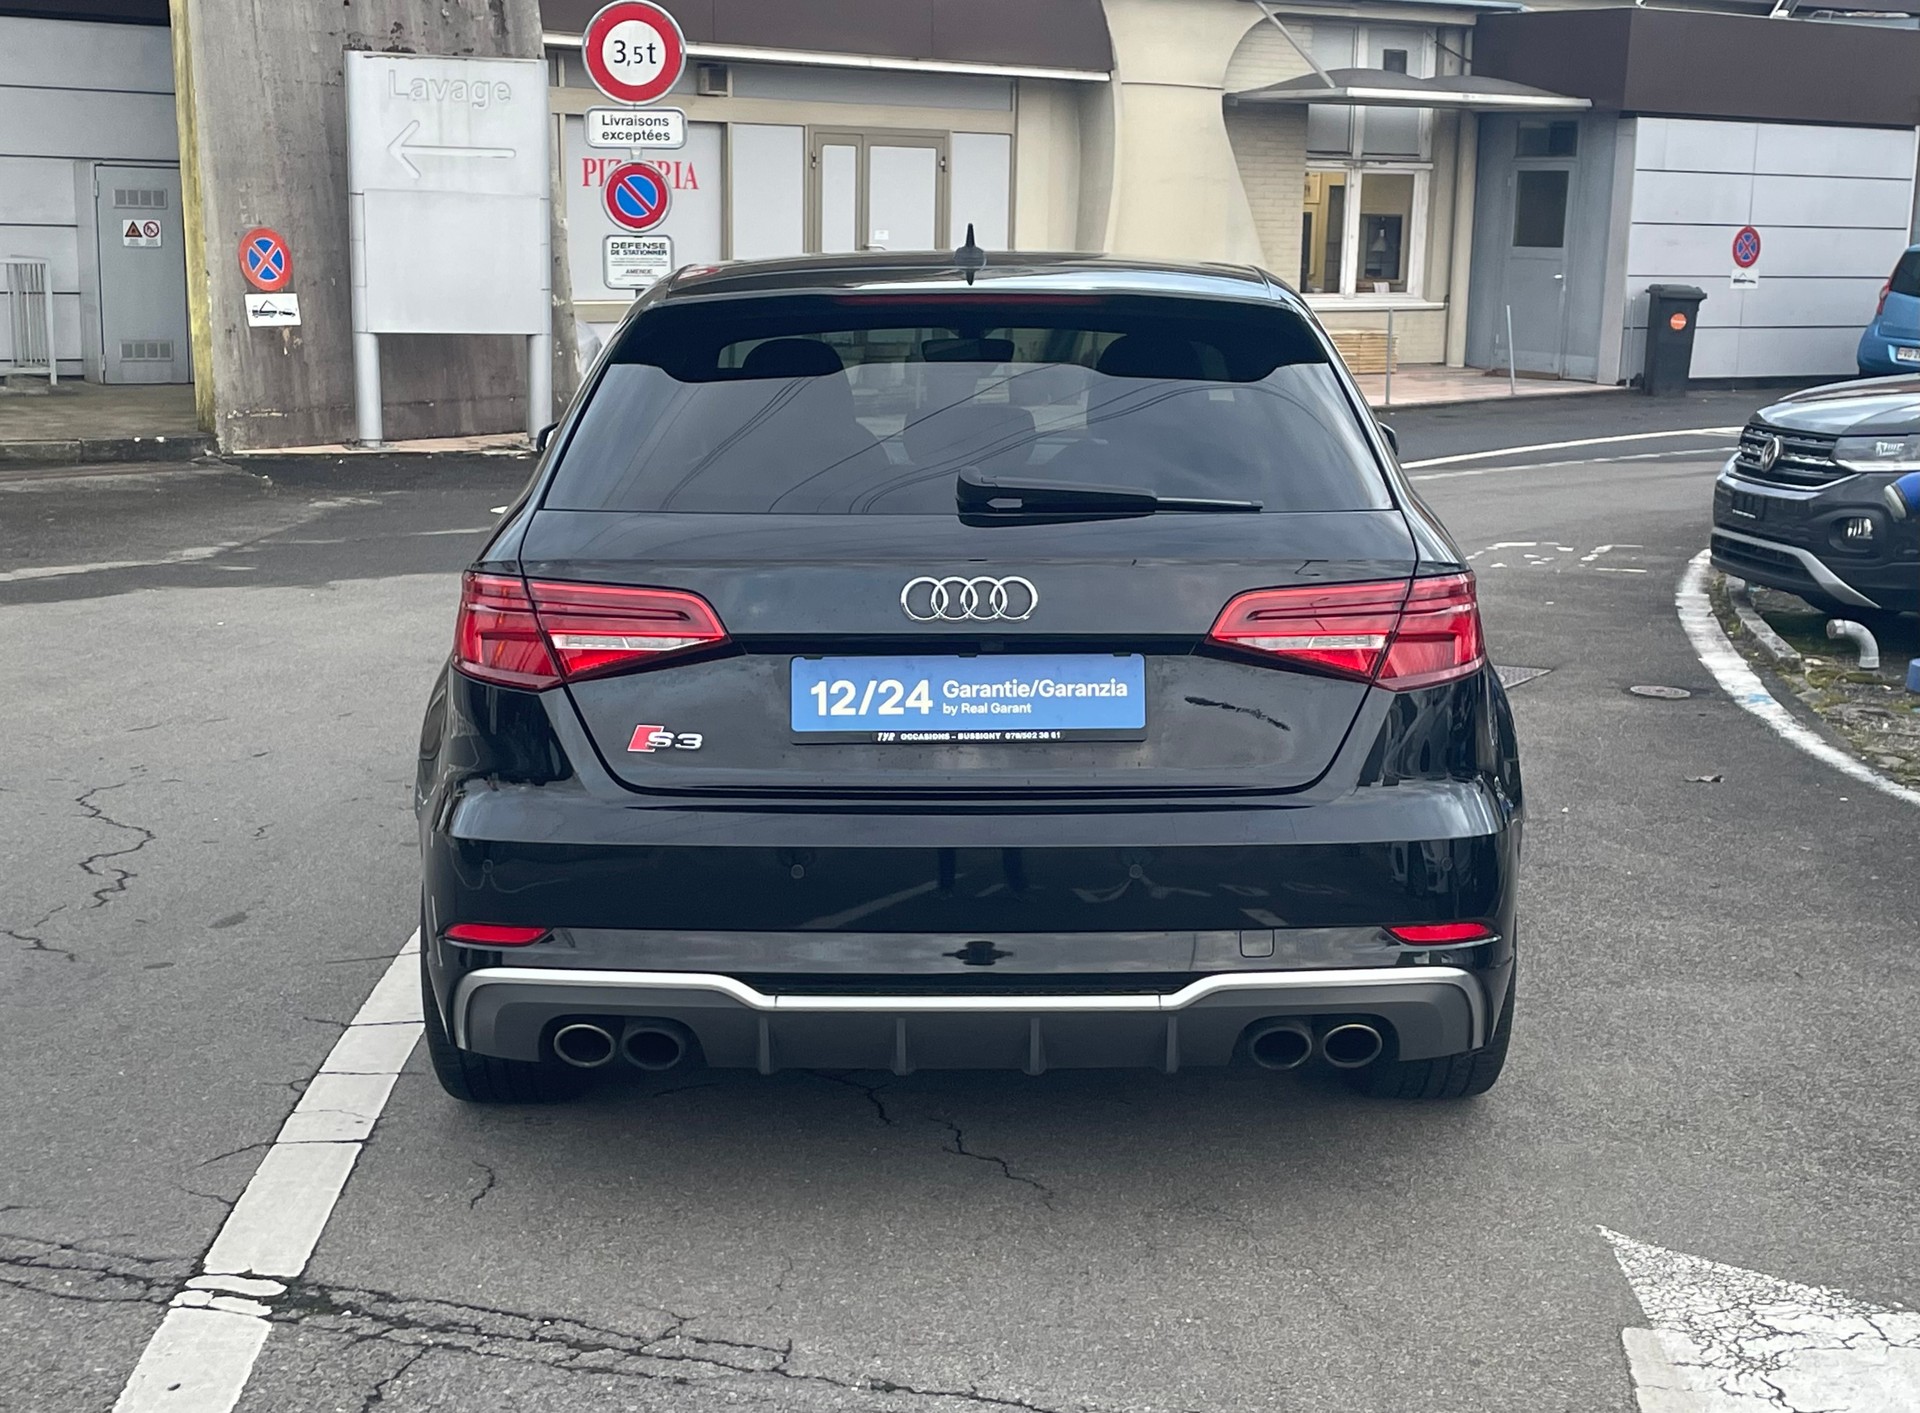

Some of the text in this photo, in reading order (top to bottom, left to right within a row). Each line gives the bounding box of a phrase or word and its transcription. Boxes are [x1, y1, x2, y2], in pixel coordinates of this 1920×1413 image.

[388, 69, 512, 110] Lavage
[601, 114, 670, 127] Livraisons
[601, 130, 671, 143] exceptées
[582, 157, 699, 190] PIRIA
[810, 679, 934, 717] 12/24
[942, 678, 1128, 699] Garantie/Garanzia
[942, 703, 1032, 717] by Real Garant
[645, 731, 703, 750] S3
[900, 732, 951, 741] OCCASIONS
[957, 731, 1002, 740] BUSSIGNY
